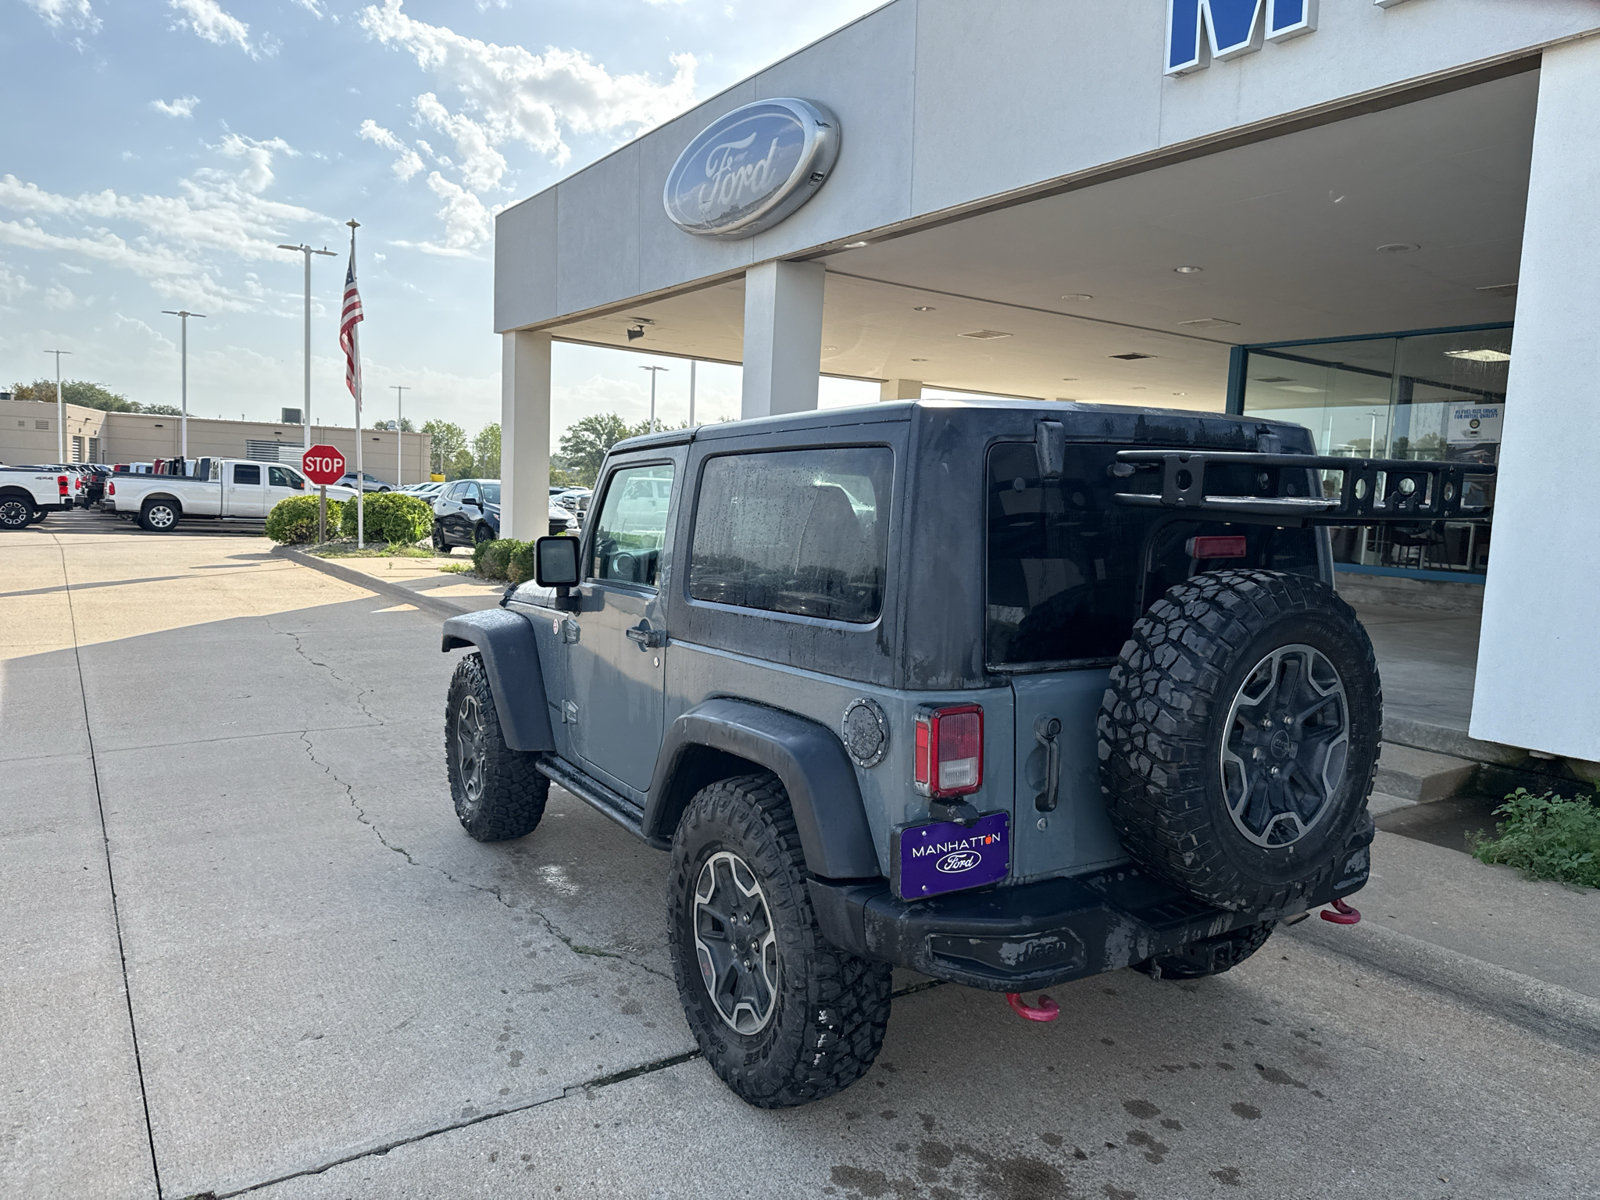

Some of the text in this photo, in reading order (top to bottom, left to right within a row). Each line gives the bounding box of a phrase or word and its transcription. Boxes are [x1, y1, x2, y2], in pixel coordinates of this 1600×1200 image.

[698, 132, 779, 207] Ford
[304, 456, 343, 473] STOP
[943, 853, 975, 871] Ford
